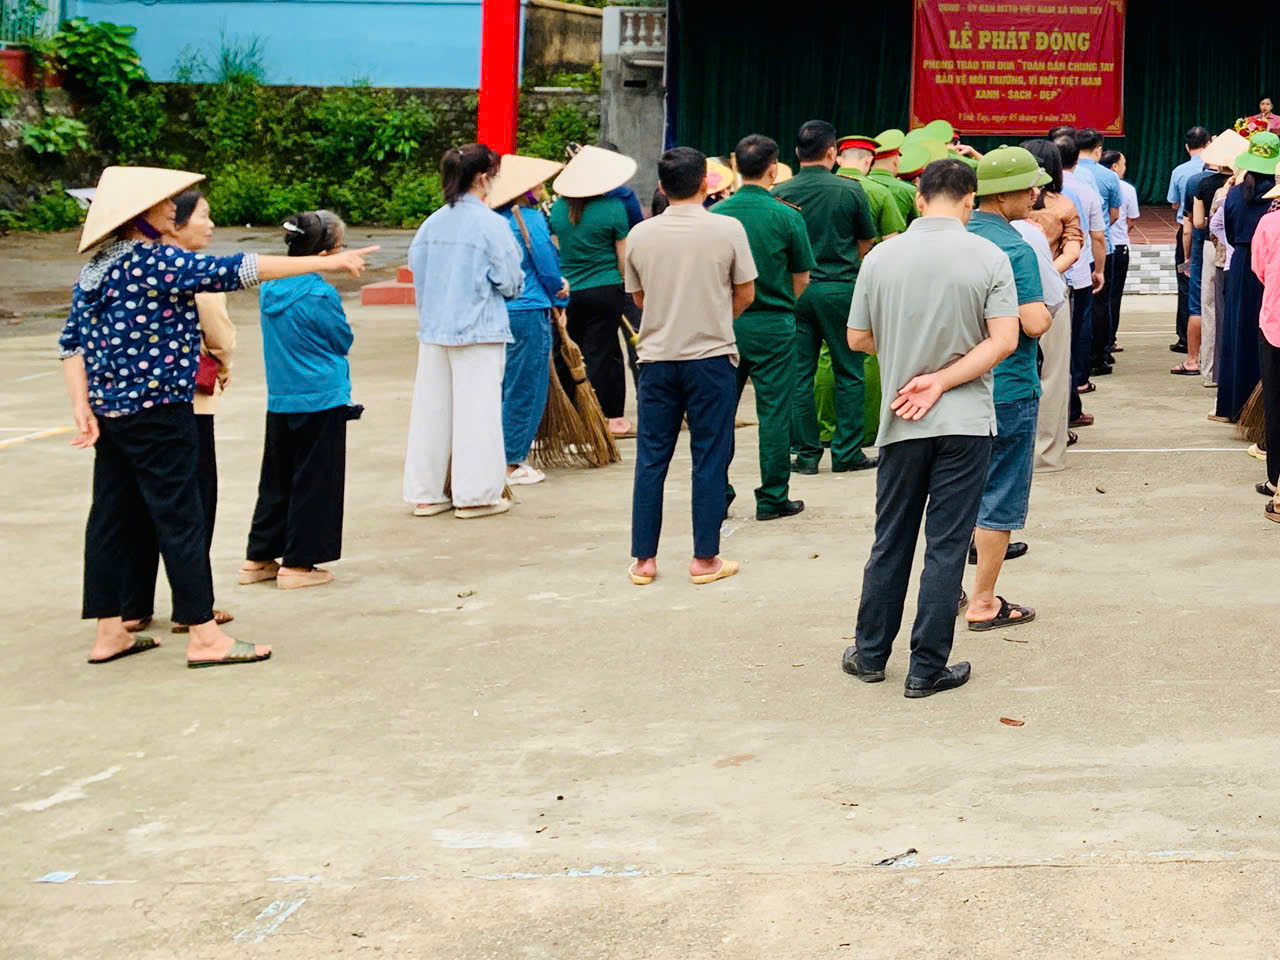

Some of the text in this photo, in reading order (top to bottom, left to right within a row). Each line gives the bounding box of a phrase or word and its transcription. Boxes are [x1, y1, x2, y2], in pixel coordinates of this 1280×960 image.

[949, 21, 1091, 55] LỄ PHÁT ĐỘNG
[923, 59, 954, 71] PHONG
[1067, 61, 1098, 72] CHUNG
[1060, 75, 1079, 87] VIỆT
[1080, 77, 1102, 86] NAM
[975, 89, 1000, 100] XANH
[1007, 89, 1032, 101] SẠCH
